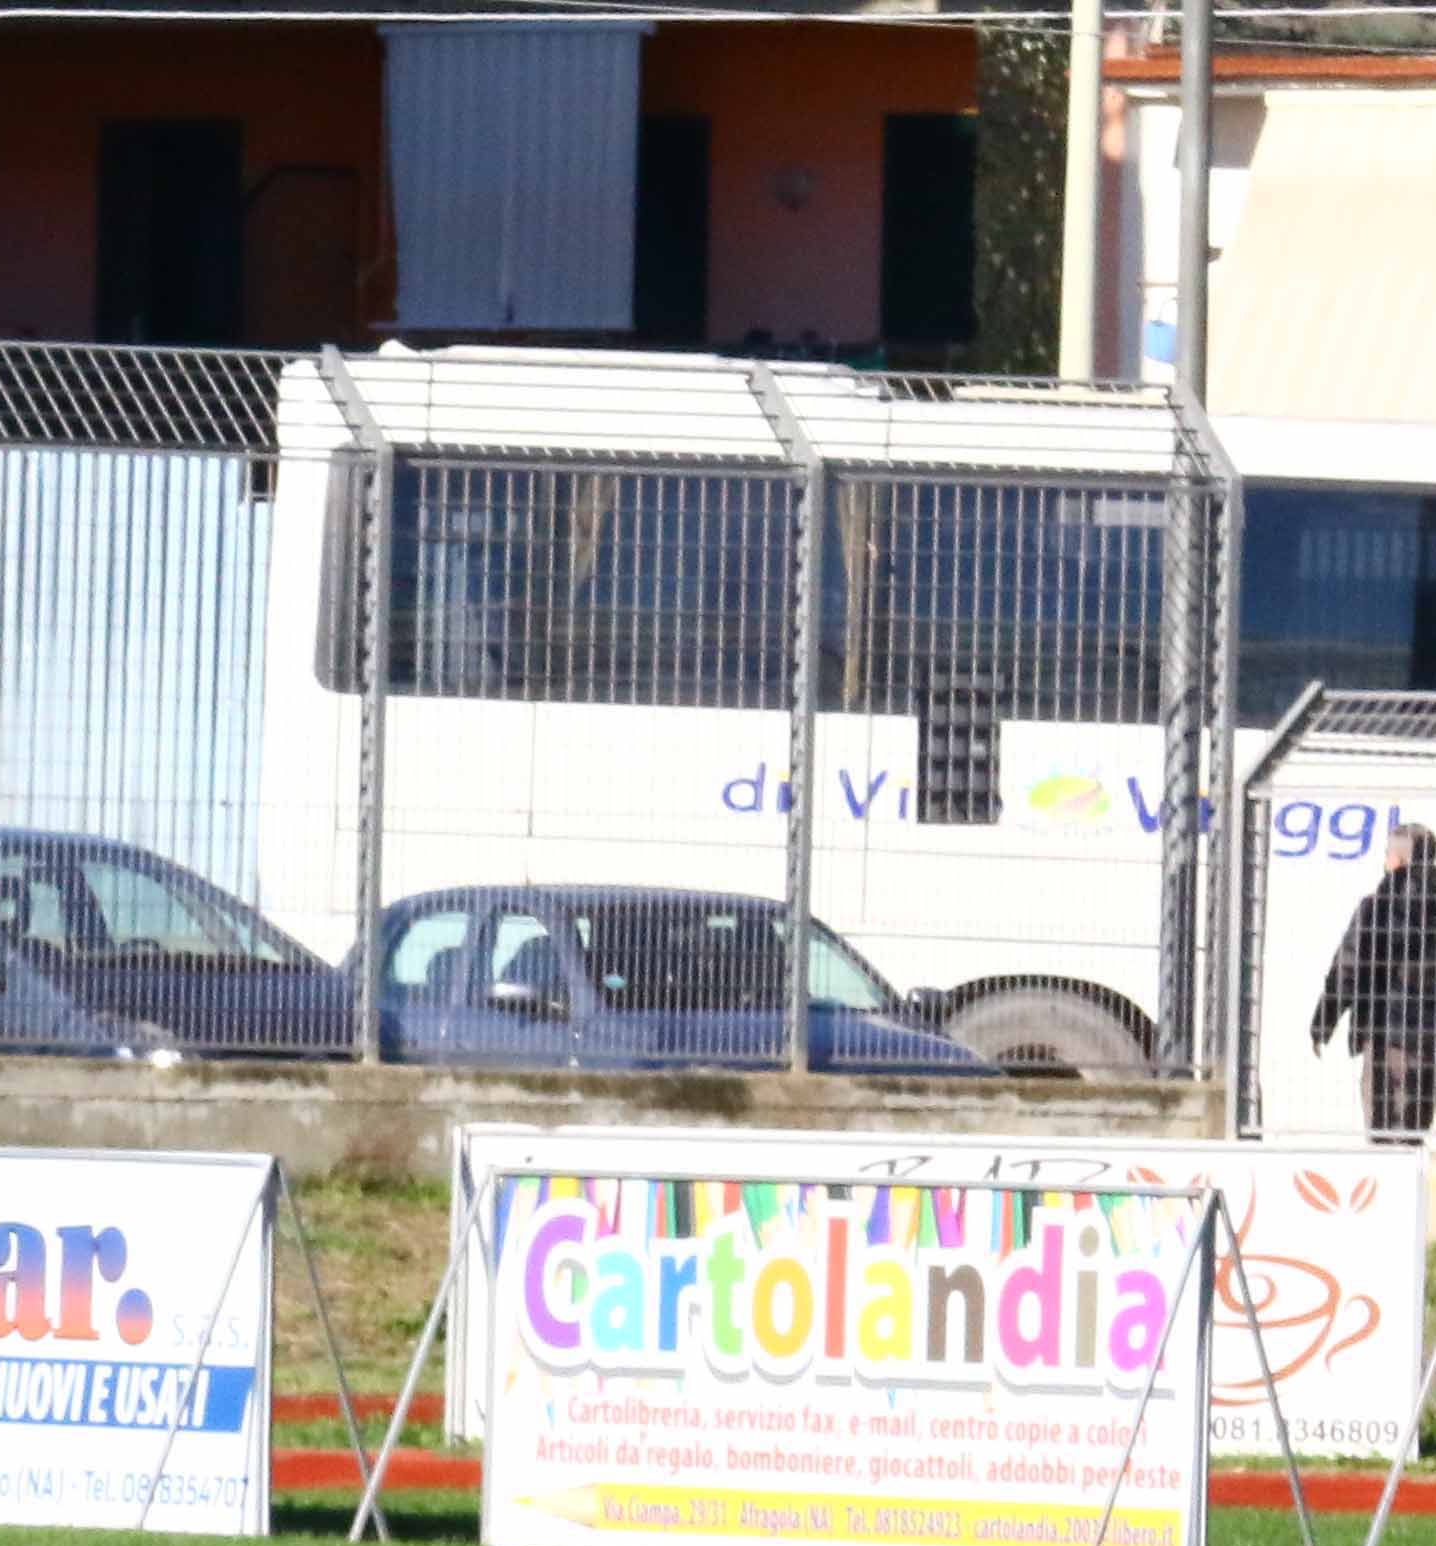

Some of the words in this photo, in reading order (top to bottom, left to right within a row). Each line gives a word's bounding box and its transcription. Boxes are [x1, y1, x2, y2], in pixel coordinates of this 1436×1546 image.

[525, 1212, 1168, 1372] Cartolandia
[89, 1366, 111, 1423] E
[567, 1397, 707, 1431] Cartolibreria,
[712, 1403, 796, 1432] servizio
[929, 1413, 999, 1441] centro
[1004, 1416, 1062, 1450] copie
[1068, 1424, 1080, 1445] a
[1085, 1416, 1148, 1448] coloi
[1211, 1415, 1400, 1445] 081.346809
[535, 1435, 609, 1465] Articoli
[615, 1440, 641, 1466] da
[726, 1440, 861, 1478] bomboniere,
[985, 1456, 1075, 1487] addobbi
